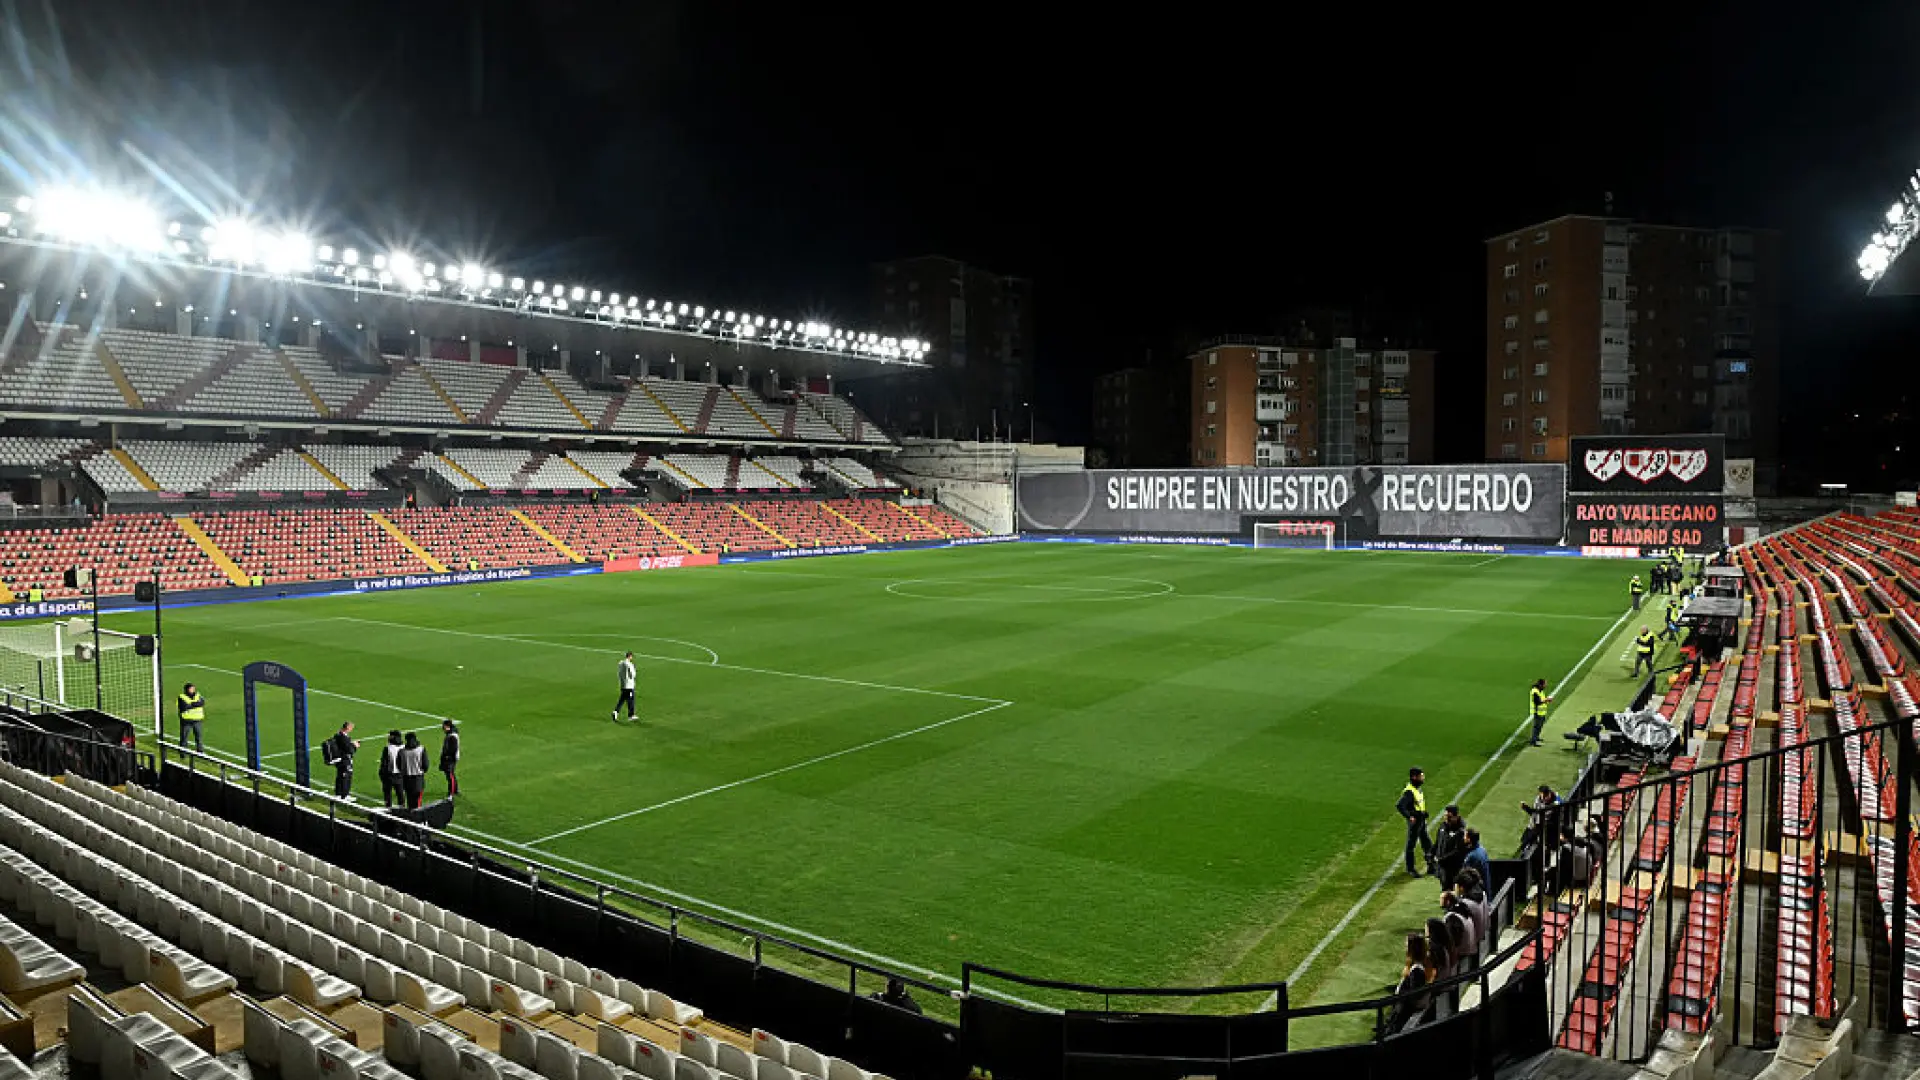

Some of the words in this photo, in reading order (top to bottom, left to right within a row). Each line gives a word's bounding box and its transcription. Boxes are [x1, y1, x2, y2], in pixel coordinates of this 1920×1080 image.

[1107, 476, 1196, 510] SIEMPRE
[1203, 476, 1231, 510] EN
[1239, 475, 1348, 511] NUESTRO
[1383, 473, 1533, 512] RECUERDO
[1576, 504, 1617, 521] RAYO
[1621, 504, 1717, 522] VALLECANO
[1279, 520, 1336, 536] RAYO
[1589, 528, 1607, 543] DE
[1612, 528, 1668, 544] MADRID
[1672, 528, 1702, 545] SAD
[370, 578, 388, 588] red
[15, 604, 36, 615] de
[39, 600, 95, 614] España
